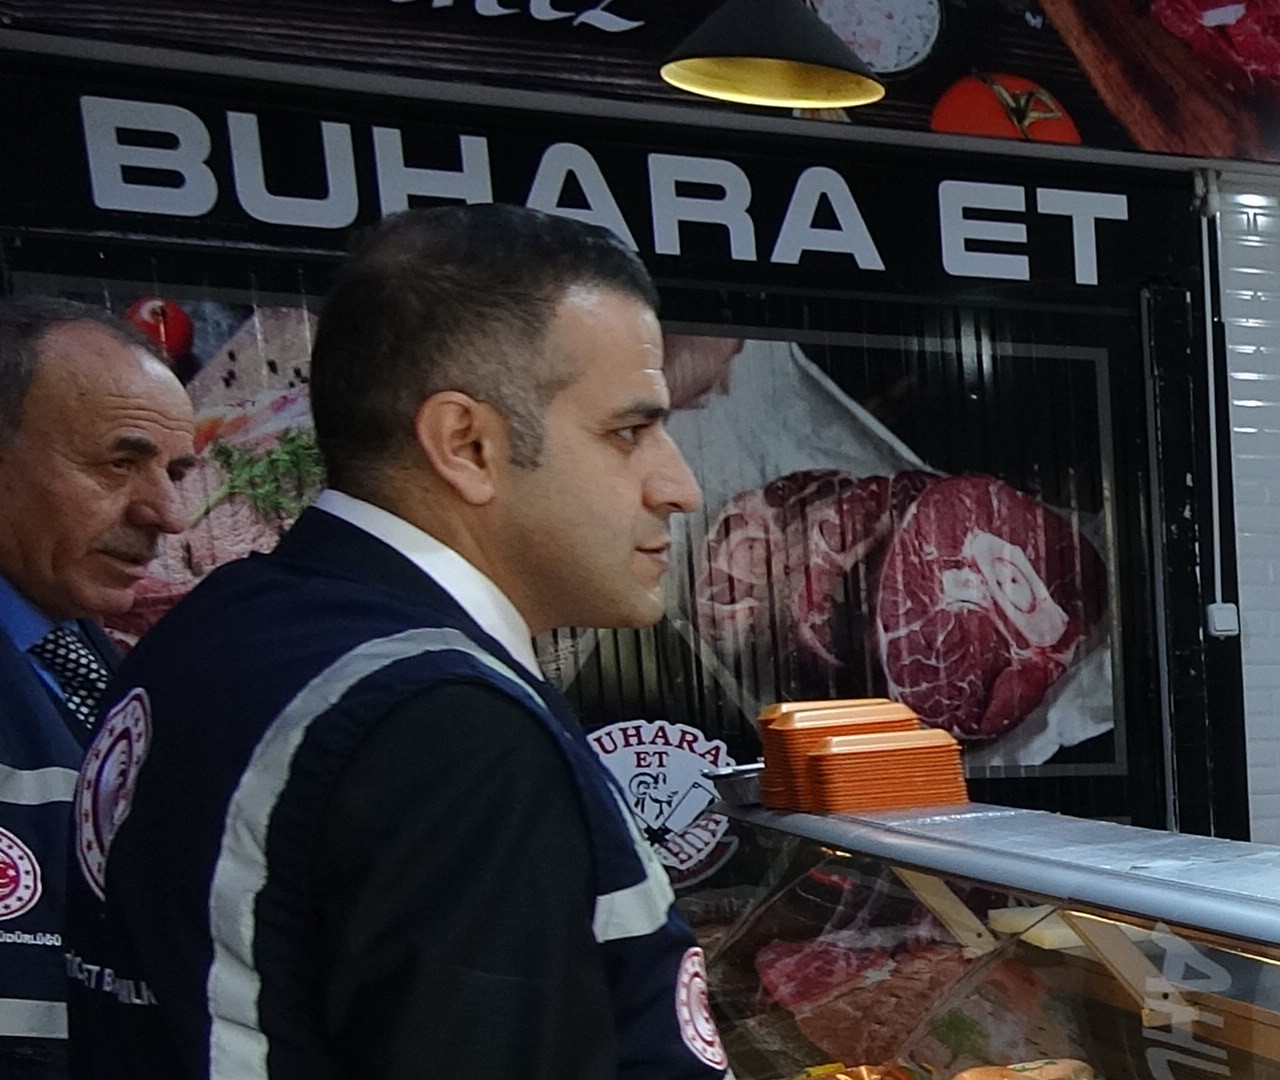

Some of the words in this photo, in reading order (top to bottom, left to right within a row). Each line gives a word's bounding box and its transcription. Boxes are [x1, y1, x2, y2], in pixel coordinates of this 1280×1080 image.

[78, 94, 884, 272] BUHARA
[937, 178, 1130, 287] ET
[592, 724, 721, 768] UHARA
[635, 750, 669, 769] ET
